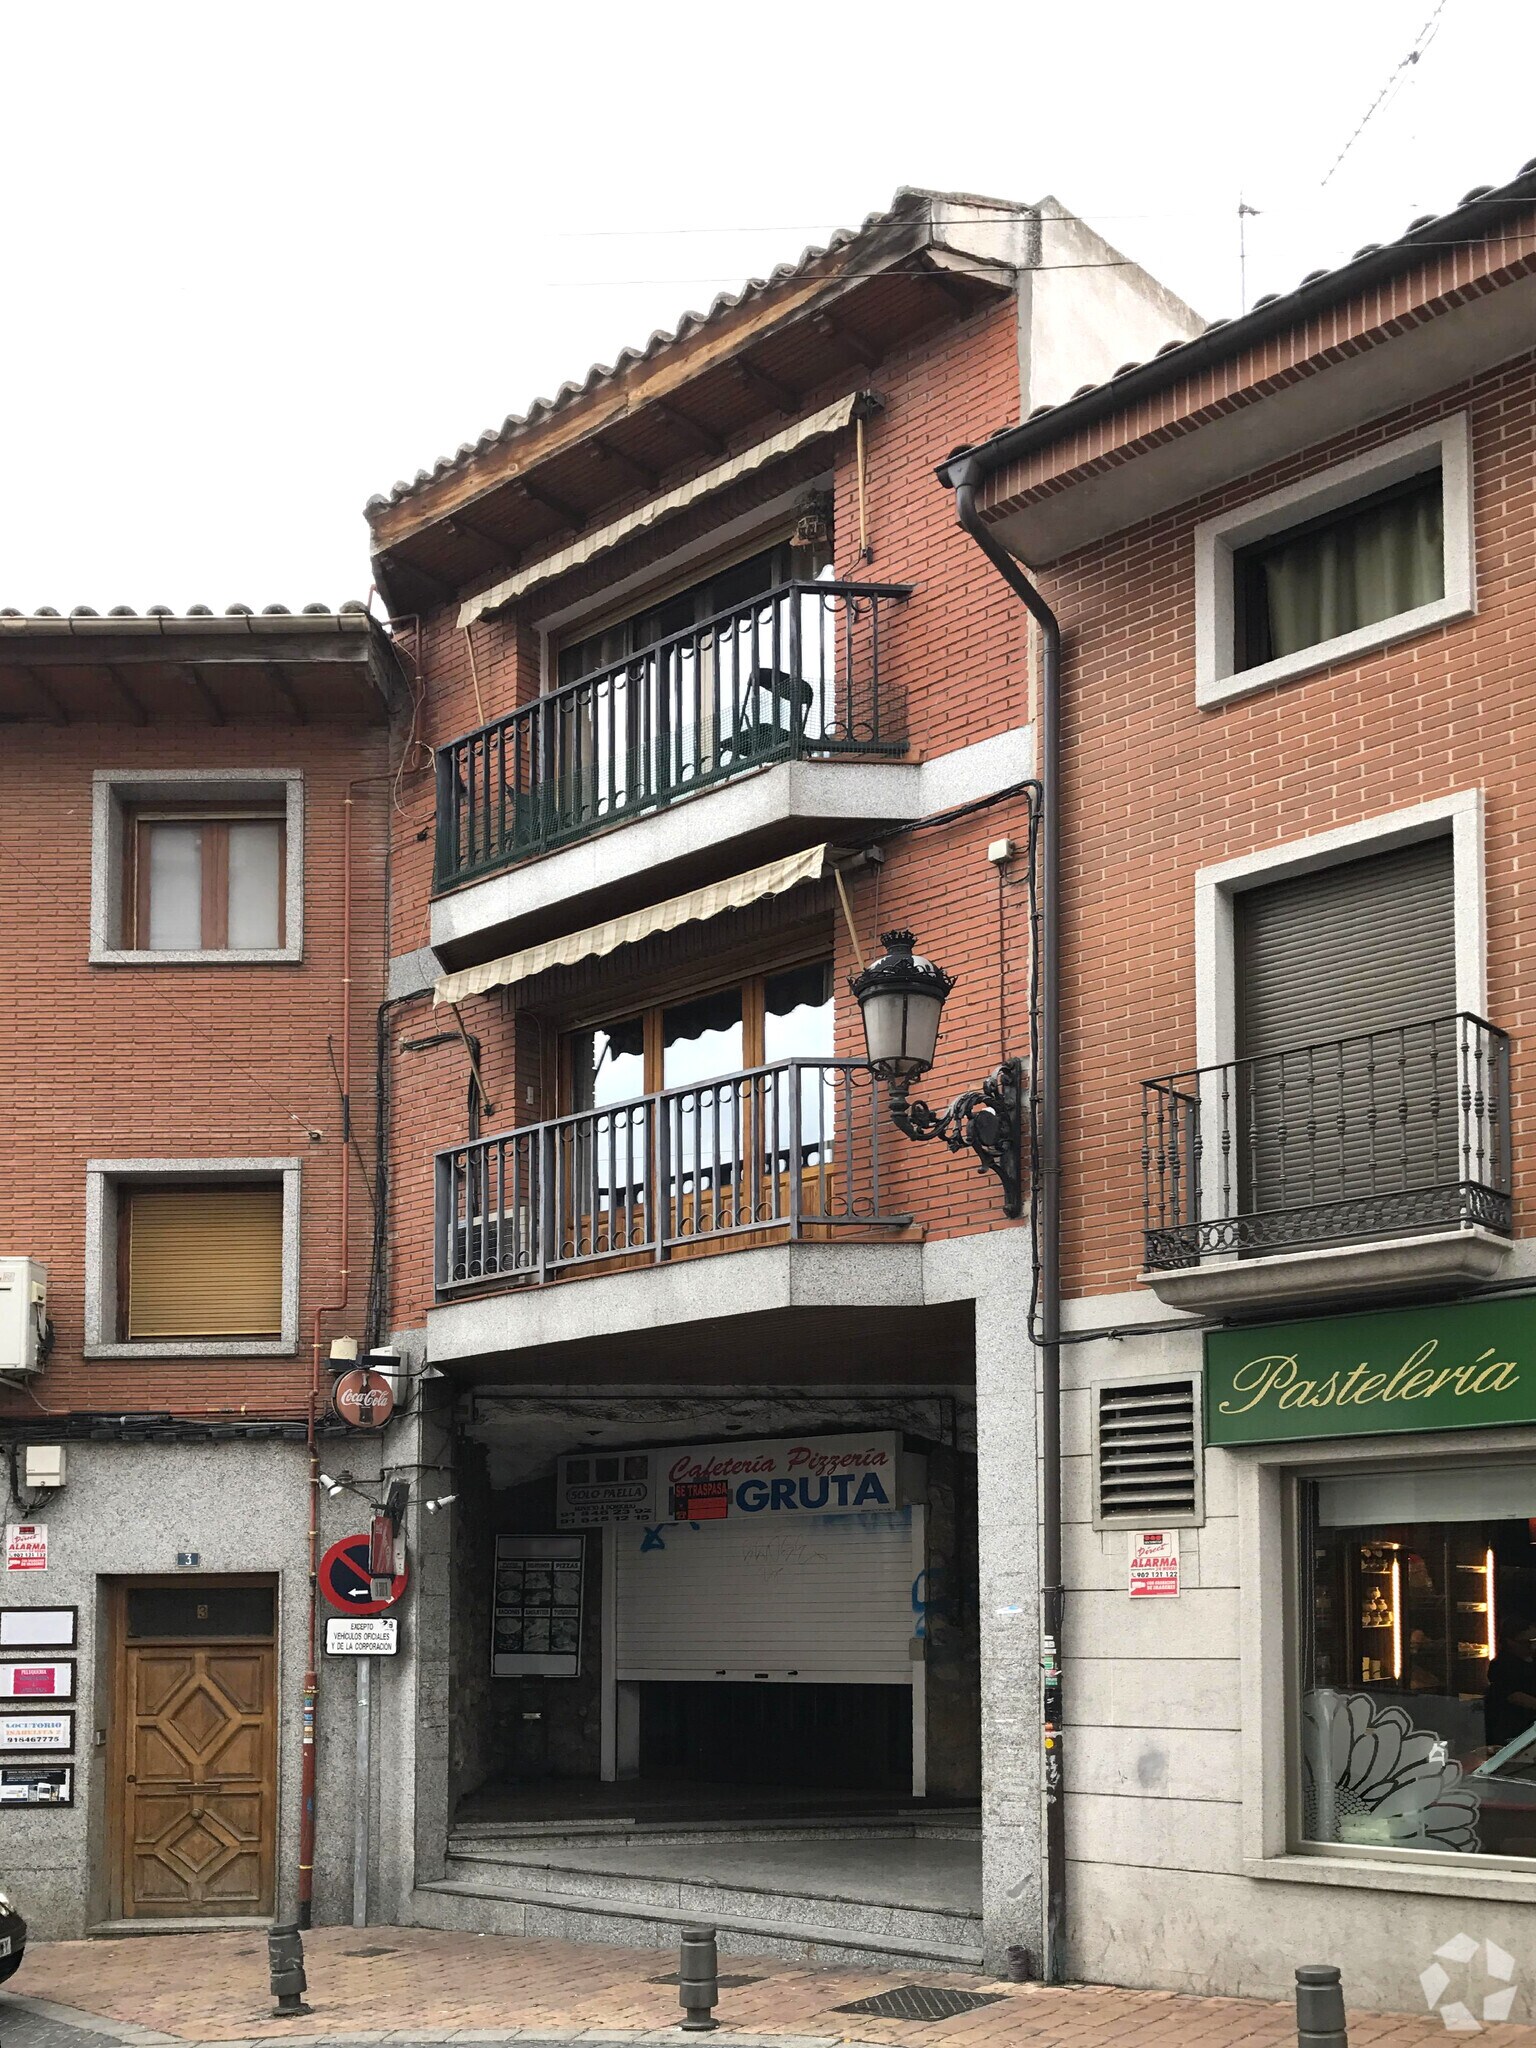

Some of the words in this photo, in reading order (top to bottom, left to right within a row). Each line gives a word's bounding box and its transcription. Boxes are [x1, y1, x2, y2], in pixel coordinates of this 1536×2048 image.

[1219, 1338, 1520, 1414] Pastelería
[668, 1454, 776, 1483] Cafetería
[787, 1446, 889, 1477] Pizzería
[571, 1489, 600, 1500] SOLO
[603, 1487, 642, 1499] PAELLA
[675, 1485, 686, 1498] SE
[687, 1481, 727, 1496] TRASPASA
[735, 1472, 889, 1512] GRUTA
[1137, 1543, 1169, 1557] Direct
[185, 1553, 192, 1565] 3
[1130, 1557, 1178, 1568] ALARMA
[199, 1606, 207, 1618] 3
[364, 1632, 390, 1640] OFICIALES
